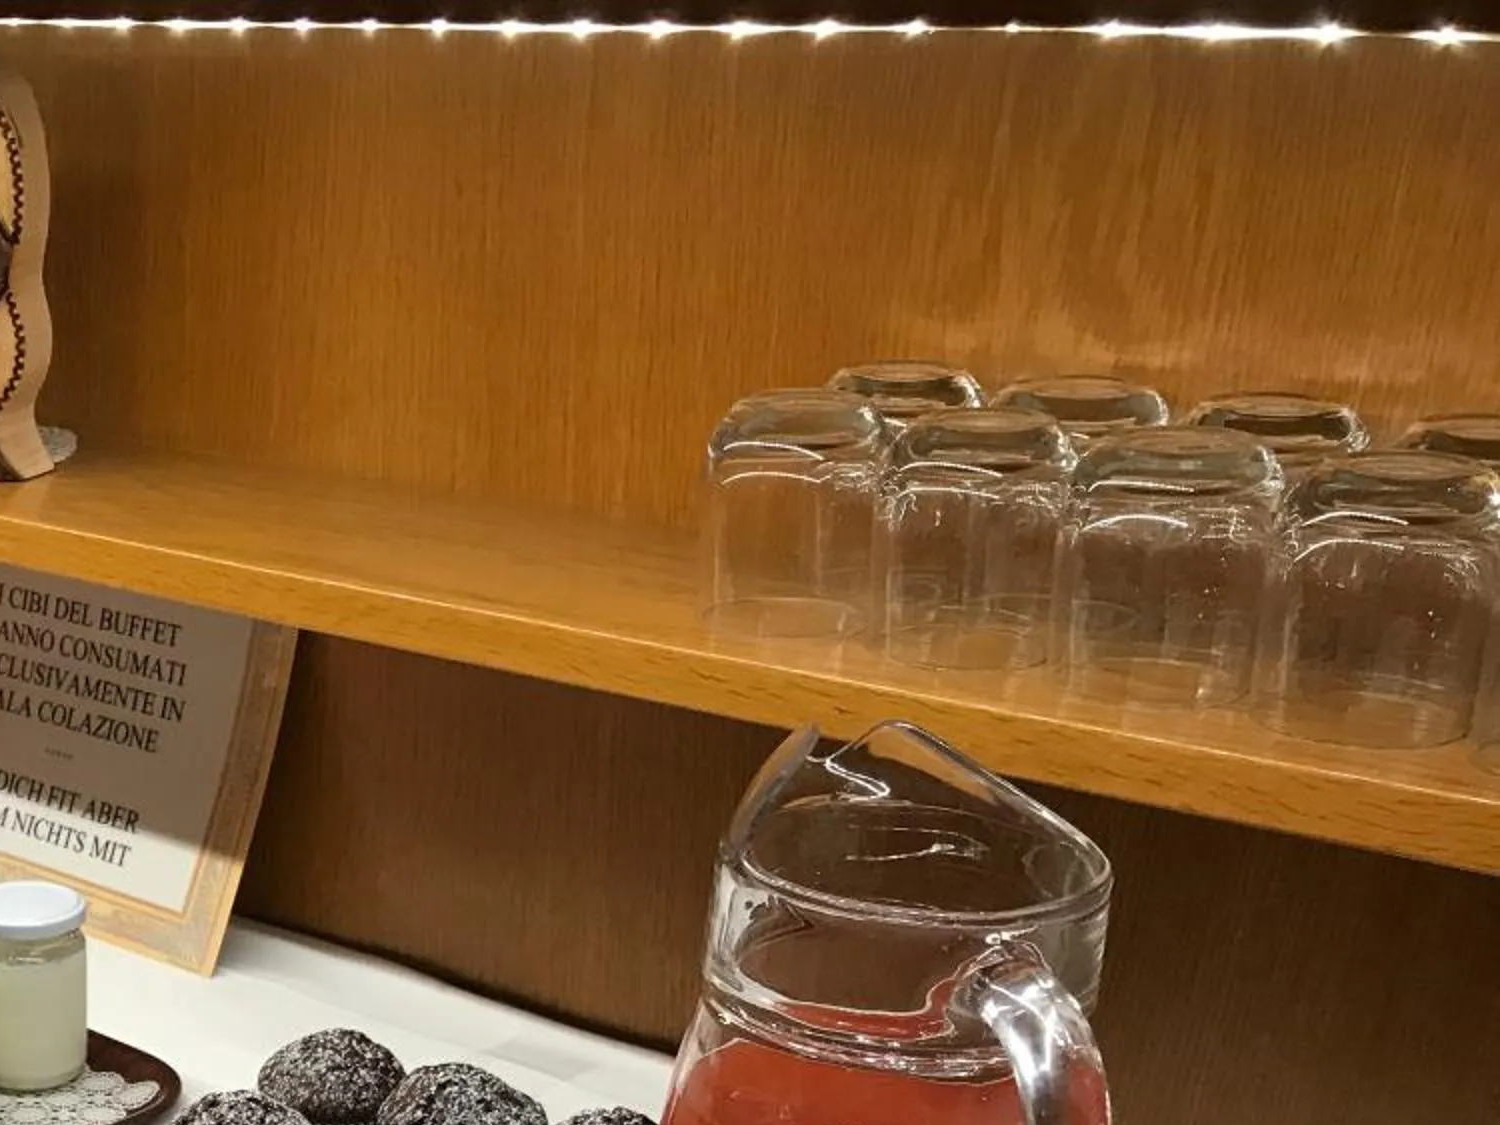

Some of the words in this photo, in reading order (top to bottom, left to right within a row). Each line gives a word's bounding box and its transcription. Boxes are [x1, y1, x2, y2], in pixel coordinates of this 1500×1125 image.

[8, 586, 50, 616] CIBI
[53, 597, 93, 627] DEL
[99, 607, 183, 647] BUFFET
[59, 634, 187, 687] CONSUMATI
[37, 700, 159, 753] COLAZIONE
[159, 696, 186, 722] IN
[46, 785, 82, 814] FIT
[81, 799, 140, 834] ABER
[11, 810, 87, 854] NICHTS
[89, 836, 132, 867] MIT
